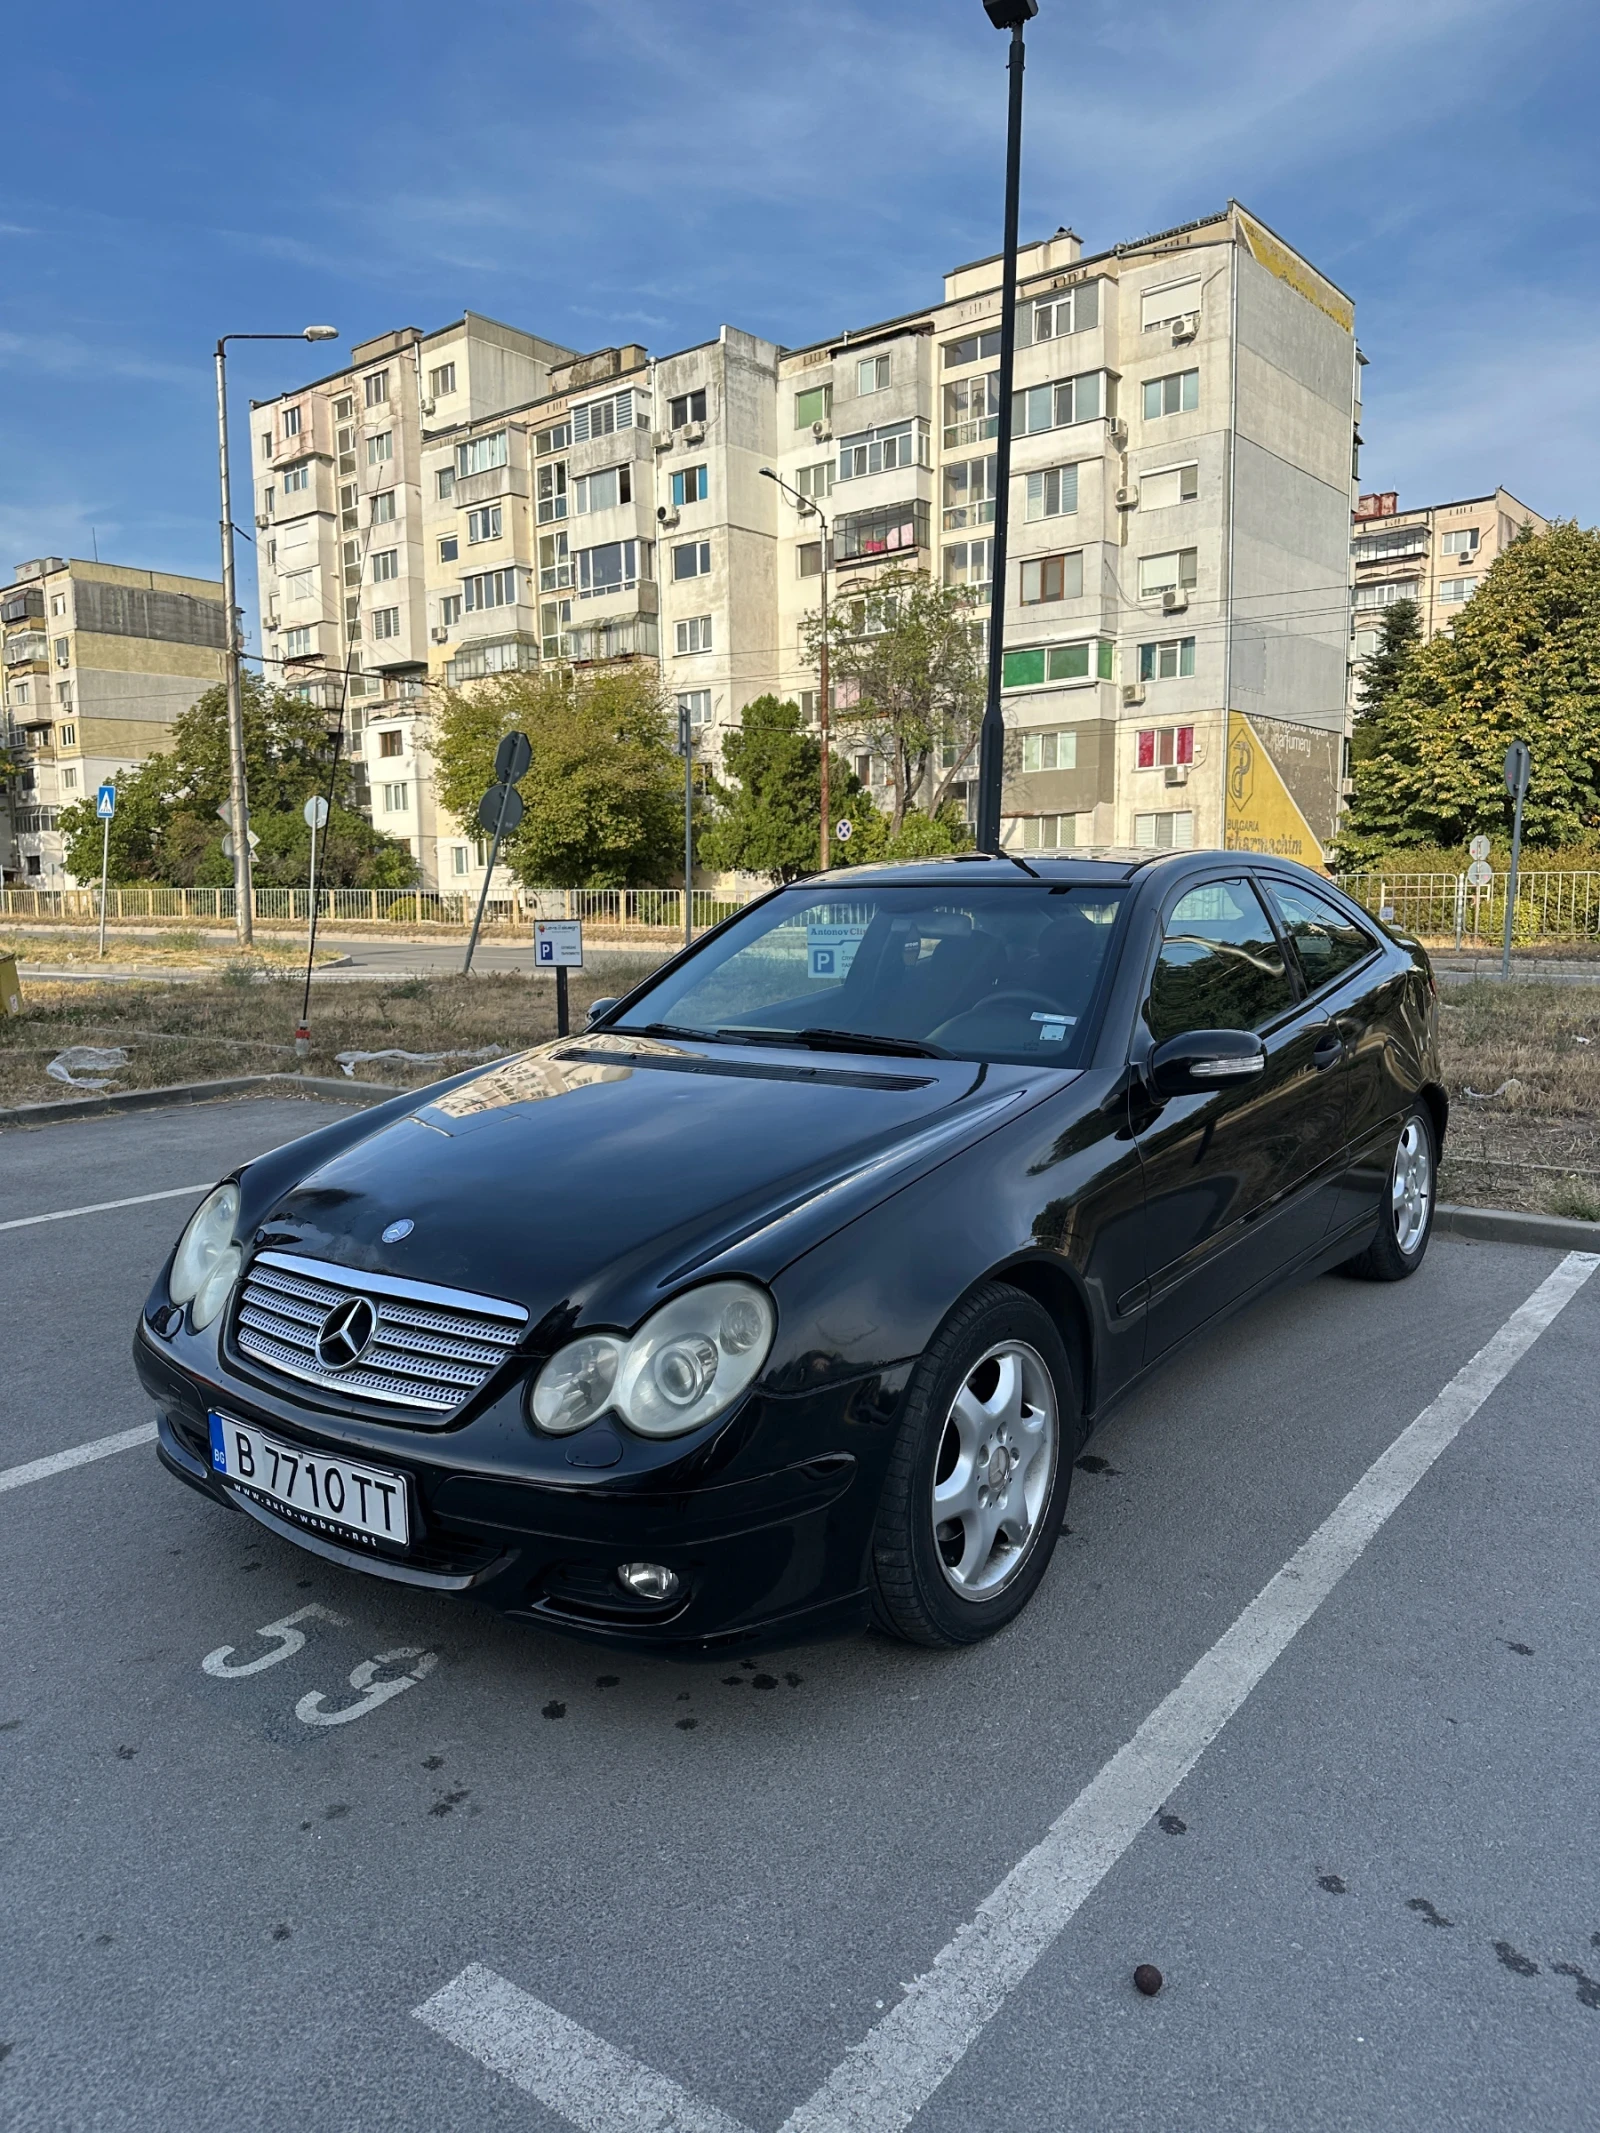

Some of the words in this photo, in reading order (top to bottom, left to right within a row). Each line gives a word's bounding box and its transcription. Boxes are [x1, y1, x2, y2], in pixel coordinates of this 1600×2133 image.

[1227, 819, 1259, 832] BULGARIA
[811, 928, 849, 936] Antonov
[542, 944, 550, 958] P
[817, 952, 830, 971] P
[214, 1448, 225, 1465] BG
[264, 1444, 345, 1514] 7710
[233, 1483, 376, 1547] www.auto-weber.net
